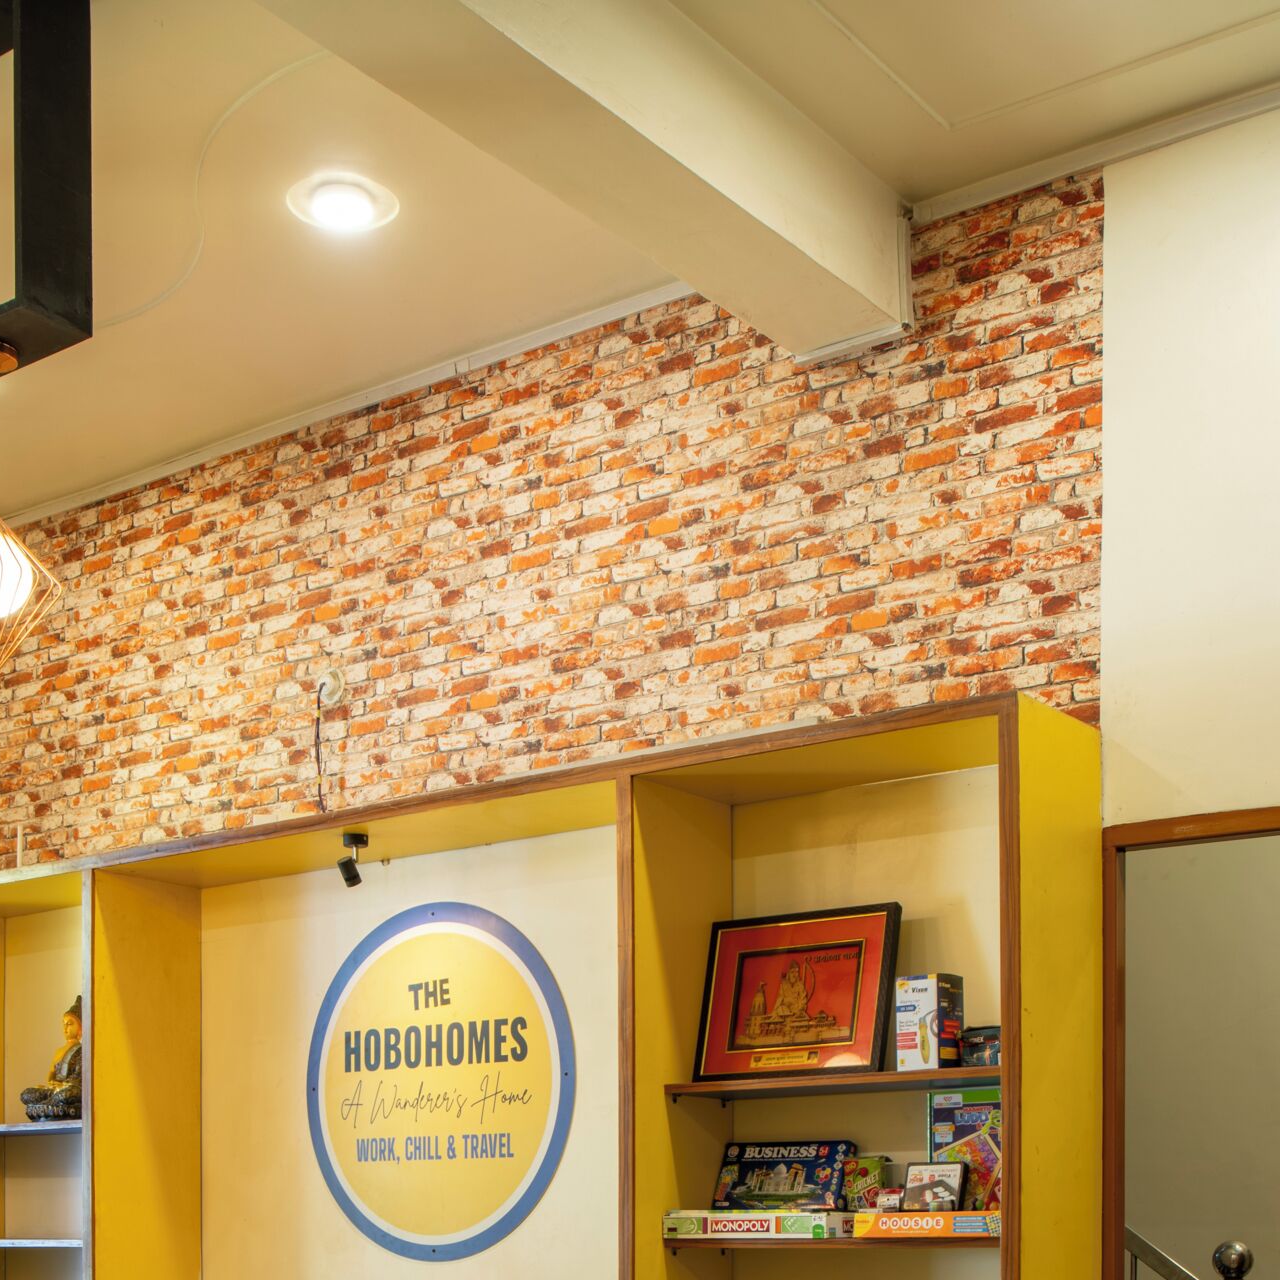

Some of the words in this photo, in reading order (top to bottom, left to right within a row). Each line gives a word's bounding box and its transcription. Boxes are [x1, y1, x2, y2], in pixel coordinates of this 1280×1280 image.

[408, 978, 451, 1011] THE
[344, 1016, 529, 1073] HOBOHOMES
[341, 1080, 363, 1128] A
[370, 1080, 467, 1125] Wanderer's
[471, 1071, 532, 1125] Home
[356, 1137, 401, 1165] WORK,
[405, 1135, 442, 1161] CHILL
[447, 1134, 457, 1160] &
[462, 1132, 514, 1159] TRAVEL
[744, 1146, 817, 1158] BUSINESS
[711, 1220, 770, 1233] MONOPOLY
[880, 1218, 942, 1228] HOUSIE
